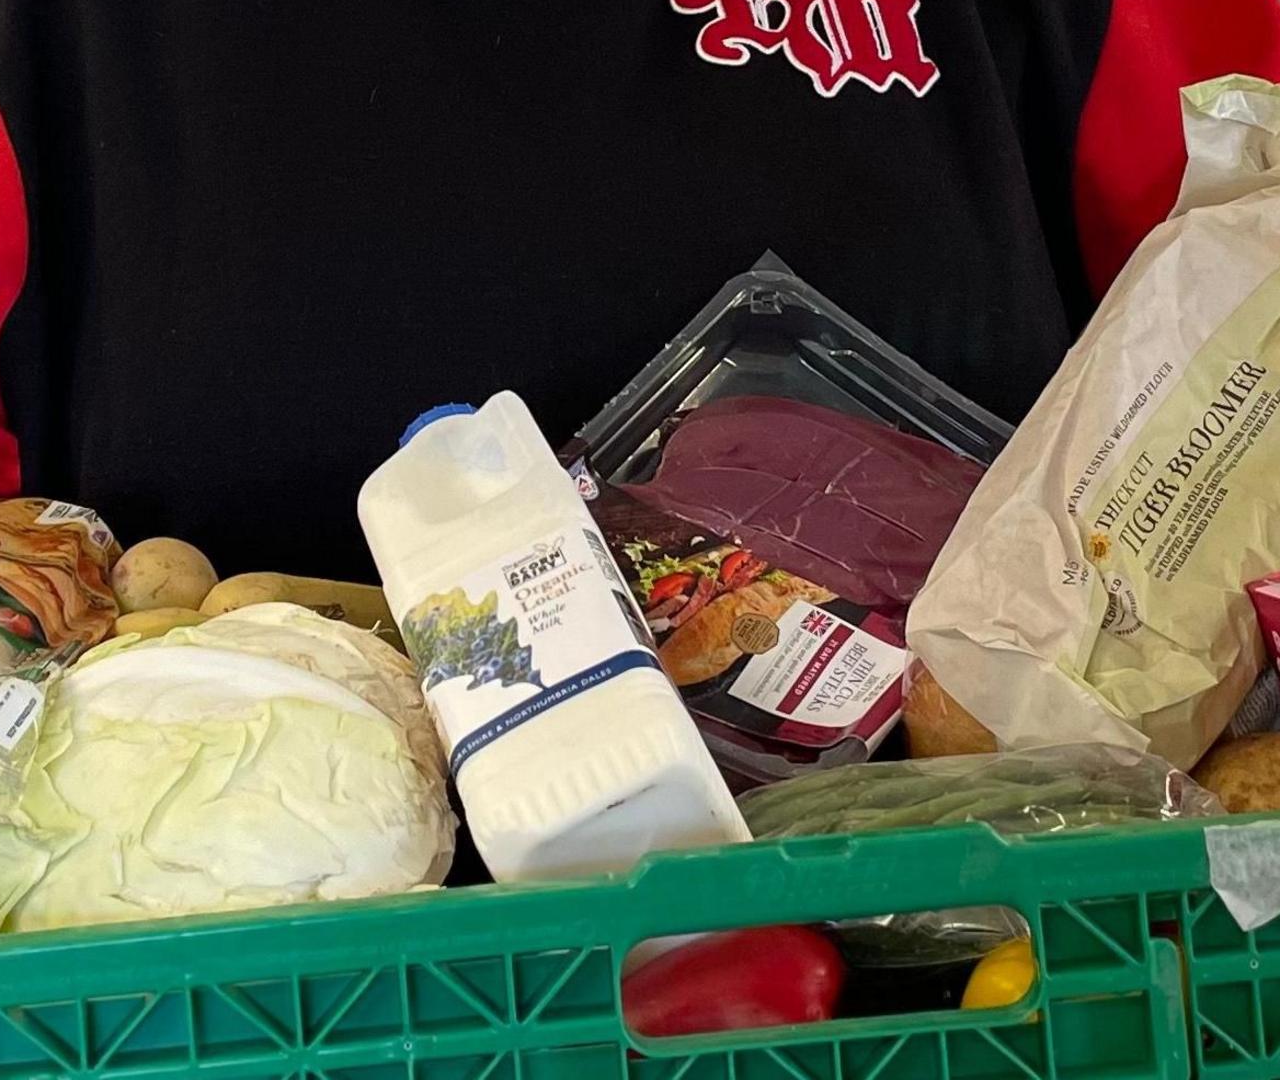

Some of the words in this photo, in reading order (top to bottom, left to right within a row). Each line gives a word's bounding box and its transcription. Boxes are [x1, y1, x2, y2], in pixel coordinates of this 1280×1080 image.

[1086, 439, 1115, 476] USING
[1110, 393, 1148, 441] WILDFARMED
[1144, 361, 1174, 396] FLOUR
[1118, 477, 1180, 558] TIGER
[1165, 361, 1267, 481] BLOOMER
[1173, 501, 1193, 524] YEAR
[1187, 482, 1205, 502] OLD
[1240, 390, 1271, 432] CULTURE
[1094, 478, 1135, 530] THICK
[1130, 450, 1155, 486] CUT
[1158, 536, 1184, 568] TOPPED
[1187, 496, 1210, 523] TIGER
[1169, 519, 1209, 574] WILDFARMED
[1204, 487, 1228, 519] FLOUR
[510, 551, 560, 580] ACORN
[511, 560, 556, 587] DAIRY
[515, 563, 593, 601] Organic.
[521, 582, 576, 612] Local.
[528, 603, 566, 624] Whole
[532, 615, 563, 635] Milk
[819, 645, 833, 661] DAY
[830, 638, 840, 648] 21
[841, 642, 868, 669] BEEF
[793, 662, 822, 696] MATURED
[847, 658, 876, 688] THIN
[806, 667, 848, 712] STEAKS
[829, 684, 854, 709] CUT
[452, 730, 494, 770] ORKSHIRE
[496, 724, 503, 733] &
[505, 683, 578, 726] NORTHUMBRIA
[581, 667, 612, 686] DALES
